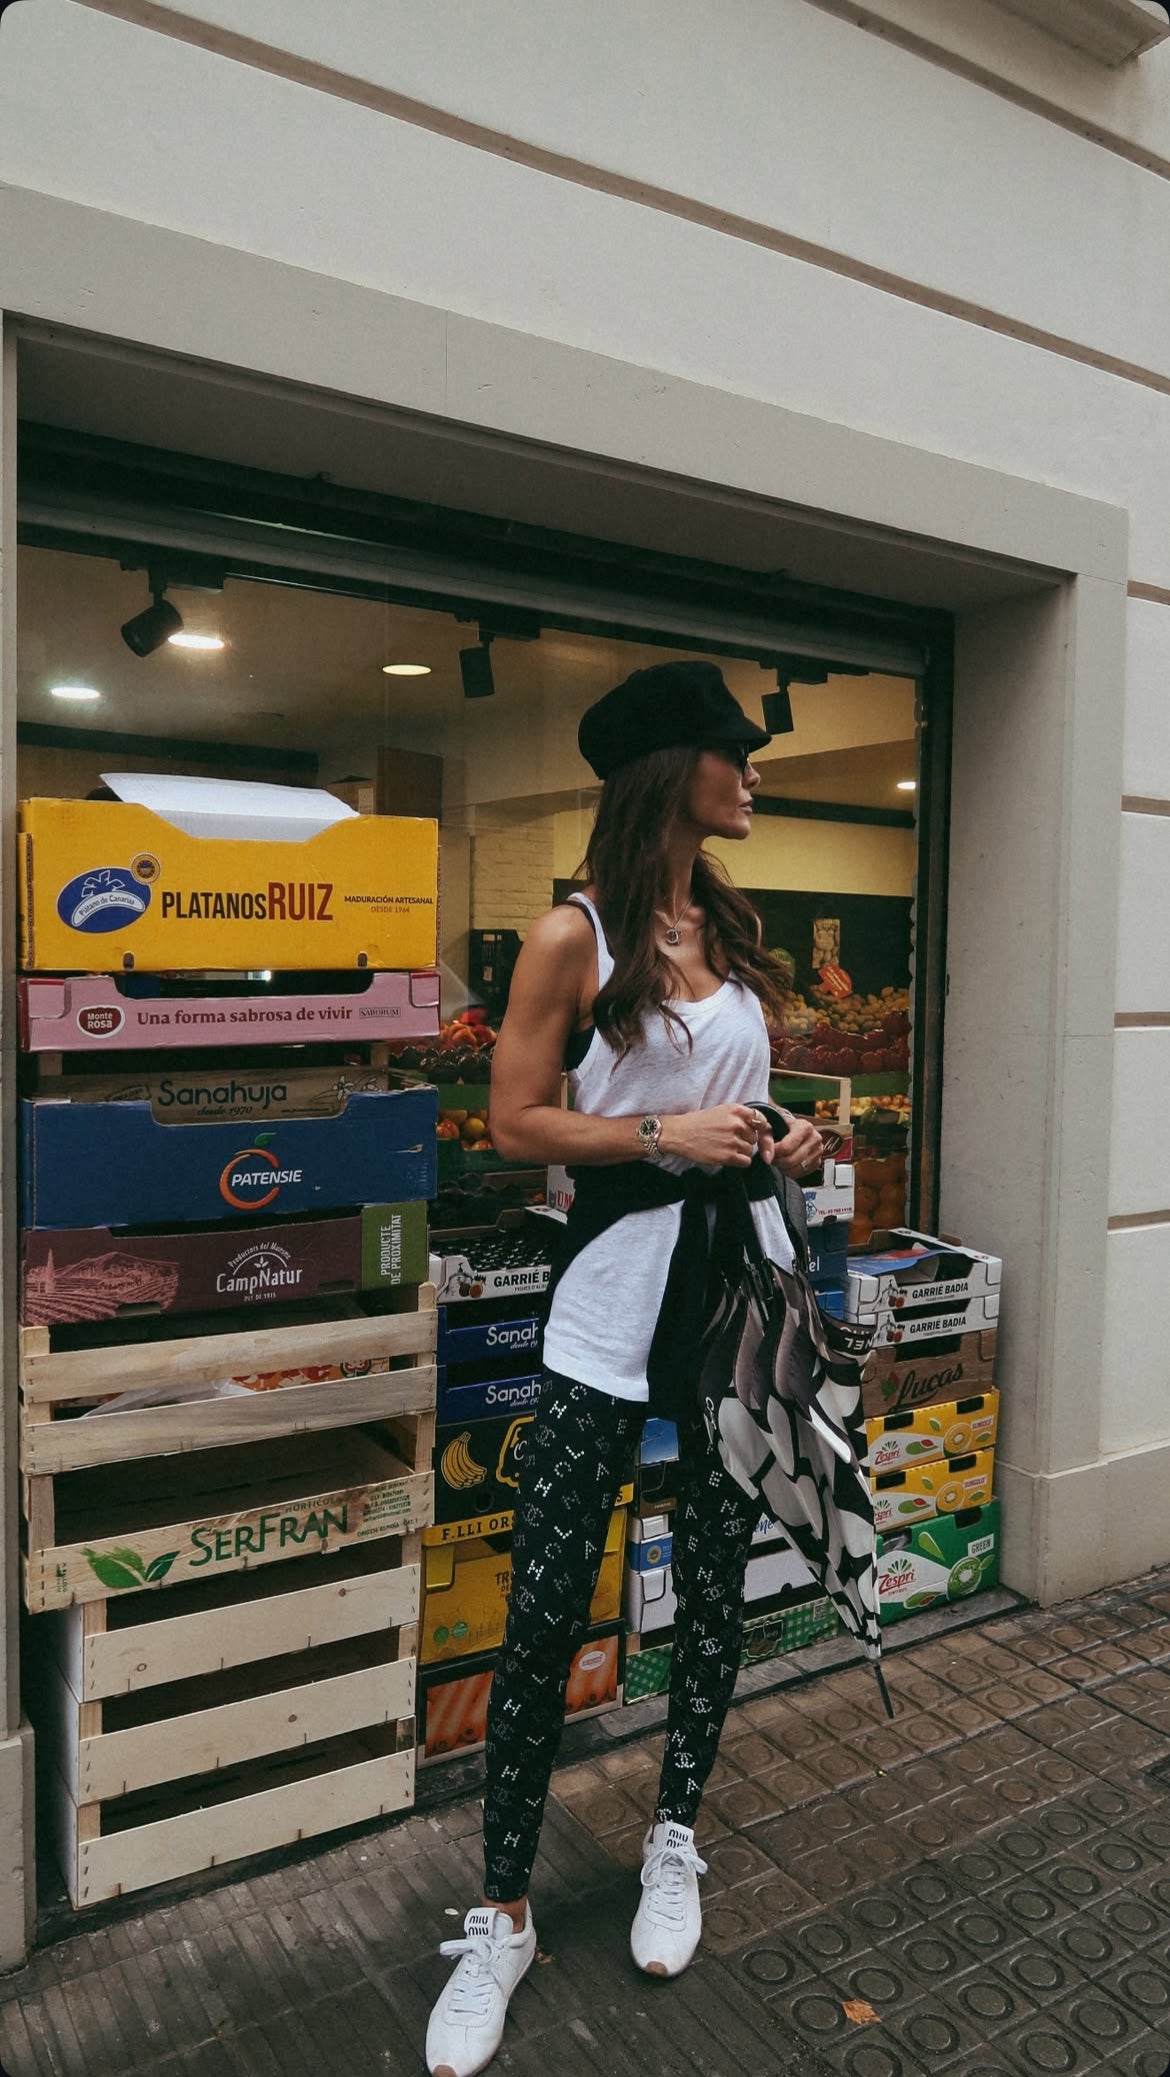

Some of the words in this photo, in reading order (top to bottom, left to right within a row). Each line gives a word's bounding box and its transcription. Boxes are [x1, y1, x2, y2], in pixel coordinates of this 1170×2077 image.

[161, 891, 267, 920] PLATANOS
[268, 882, 334, 921] RUIZ
[344, 895, 394, 905] MADURACIÓN
[395, 897, 433, 905] ARTESANAL
[87, 1012, 113, 1020] Monte
[137, 1012, 170, 1025] Una
[175, 1010, 226, 1024] forma
[230, 1009, 293, 1023] sabrosa
[296, 1007, 315, 1021] de
[319, 1006, 353, 1020] vivir
[158, 1079, 287, 1110] Sanahuja
[197, 1105, 226, 1117] desde
[229, 1105, 253, 1117] 1970
[232, 1169, 303, 1187] PATENSIE
[260, 1242, 270, 1251] del
[380, 1224, 391, 1277] PRODUCTE
[391, 1214, 401, 1272] PROXIMITAT
[216, 1268, 303, 1294] CampNatur
[391, 1273, 401, 1285] DE
[494, 1269, 539, 1287] GARRIÉ
[912, 1284, 944, 1299] GARRIÉ
[945, 1282, 969, 1296] BADIA
[910, 1318, 941, 1334] GARRIÉ
[943, 1316, 966, 1330] BADIA
[875, 1449, 900, 1466] Zespri
[442, 1522, 482, 1541] F.LLI
[971, 1538, 992, 1554] GREEN
[879, 1568, 916, 1596] Zespri
